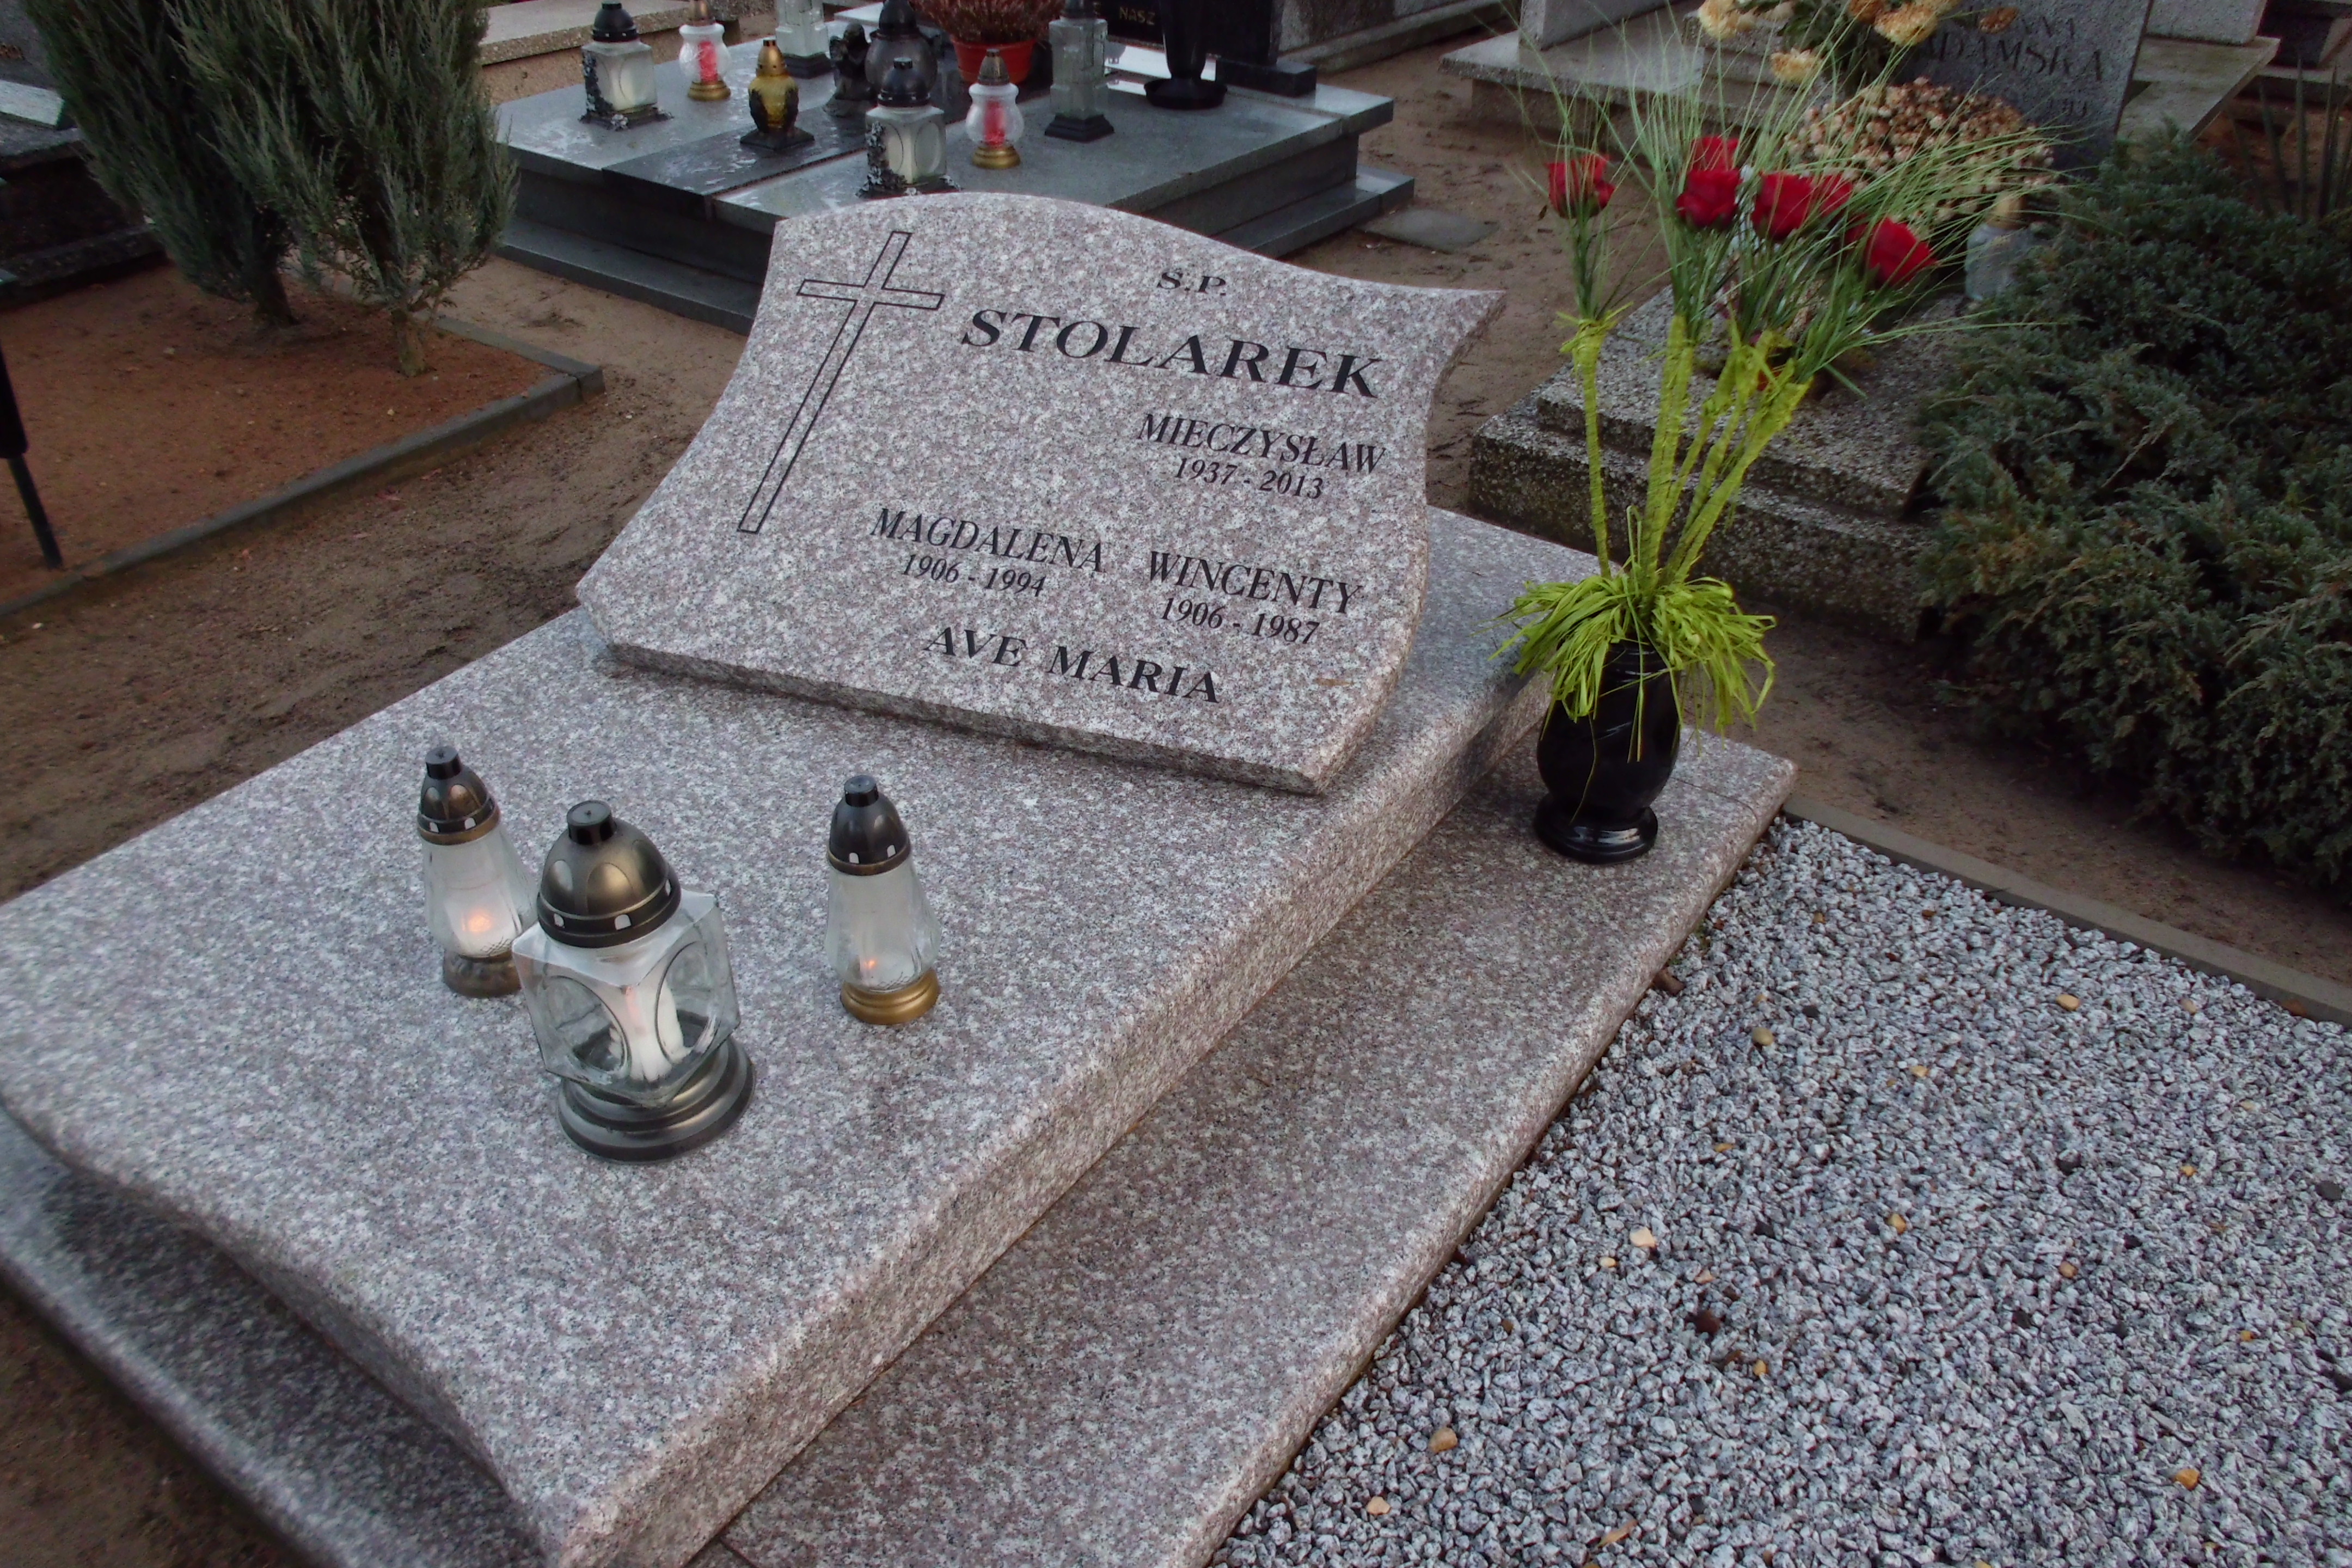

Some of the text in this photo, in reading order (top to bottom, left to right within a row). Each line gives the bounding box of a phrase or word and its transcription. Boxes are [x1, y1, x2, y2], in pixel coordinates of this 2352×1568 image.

[961, 310, 1382, 397] STOLAREK
[1137, 414, 1386, 474] MIECZYSŁAW
[1174, 458, 1237, 485] 1937
[1259, 470, 1323, 499] 2013
[870, 508, 1106, 572] MAGDALENA
[903, 554, 963, 583] 1906
[985, 568, 1046, 597] 1994
[1150, 551, 1363, 614] WINCENTY
[1161, 598, 1226, 629] 1906
[1252, 613, 1320, 645] 1987
[925, 627, 1220, 703] AVE MARIA
